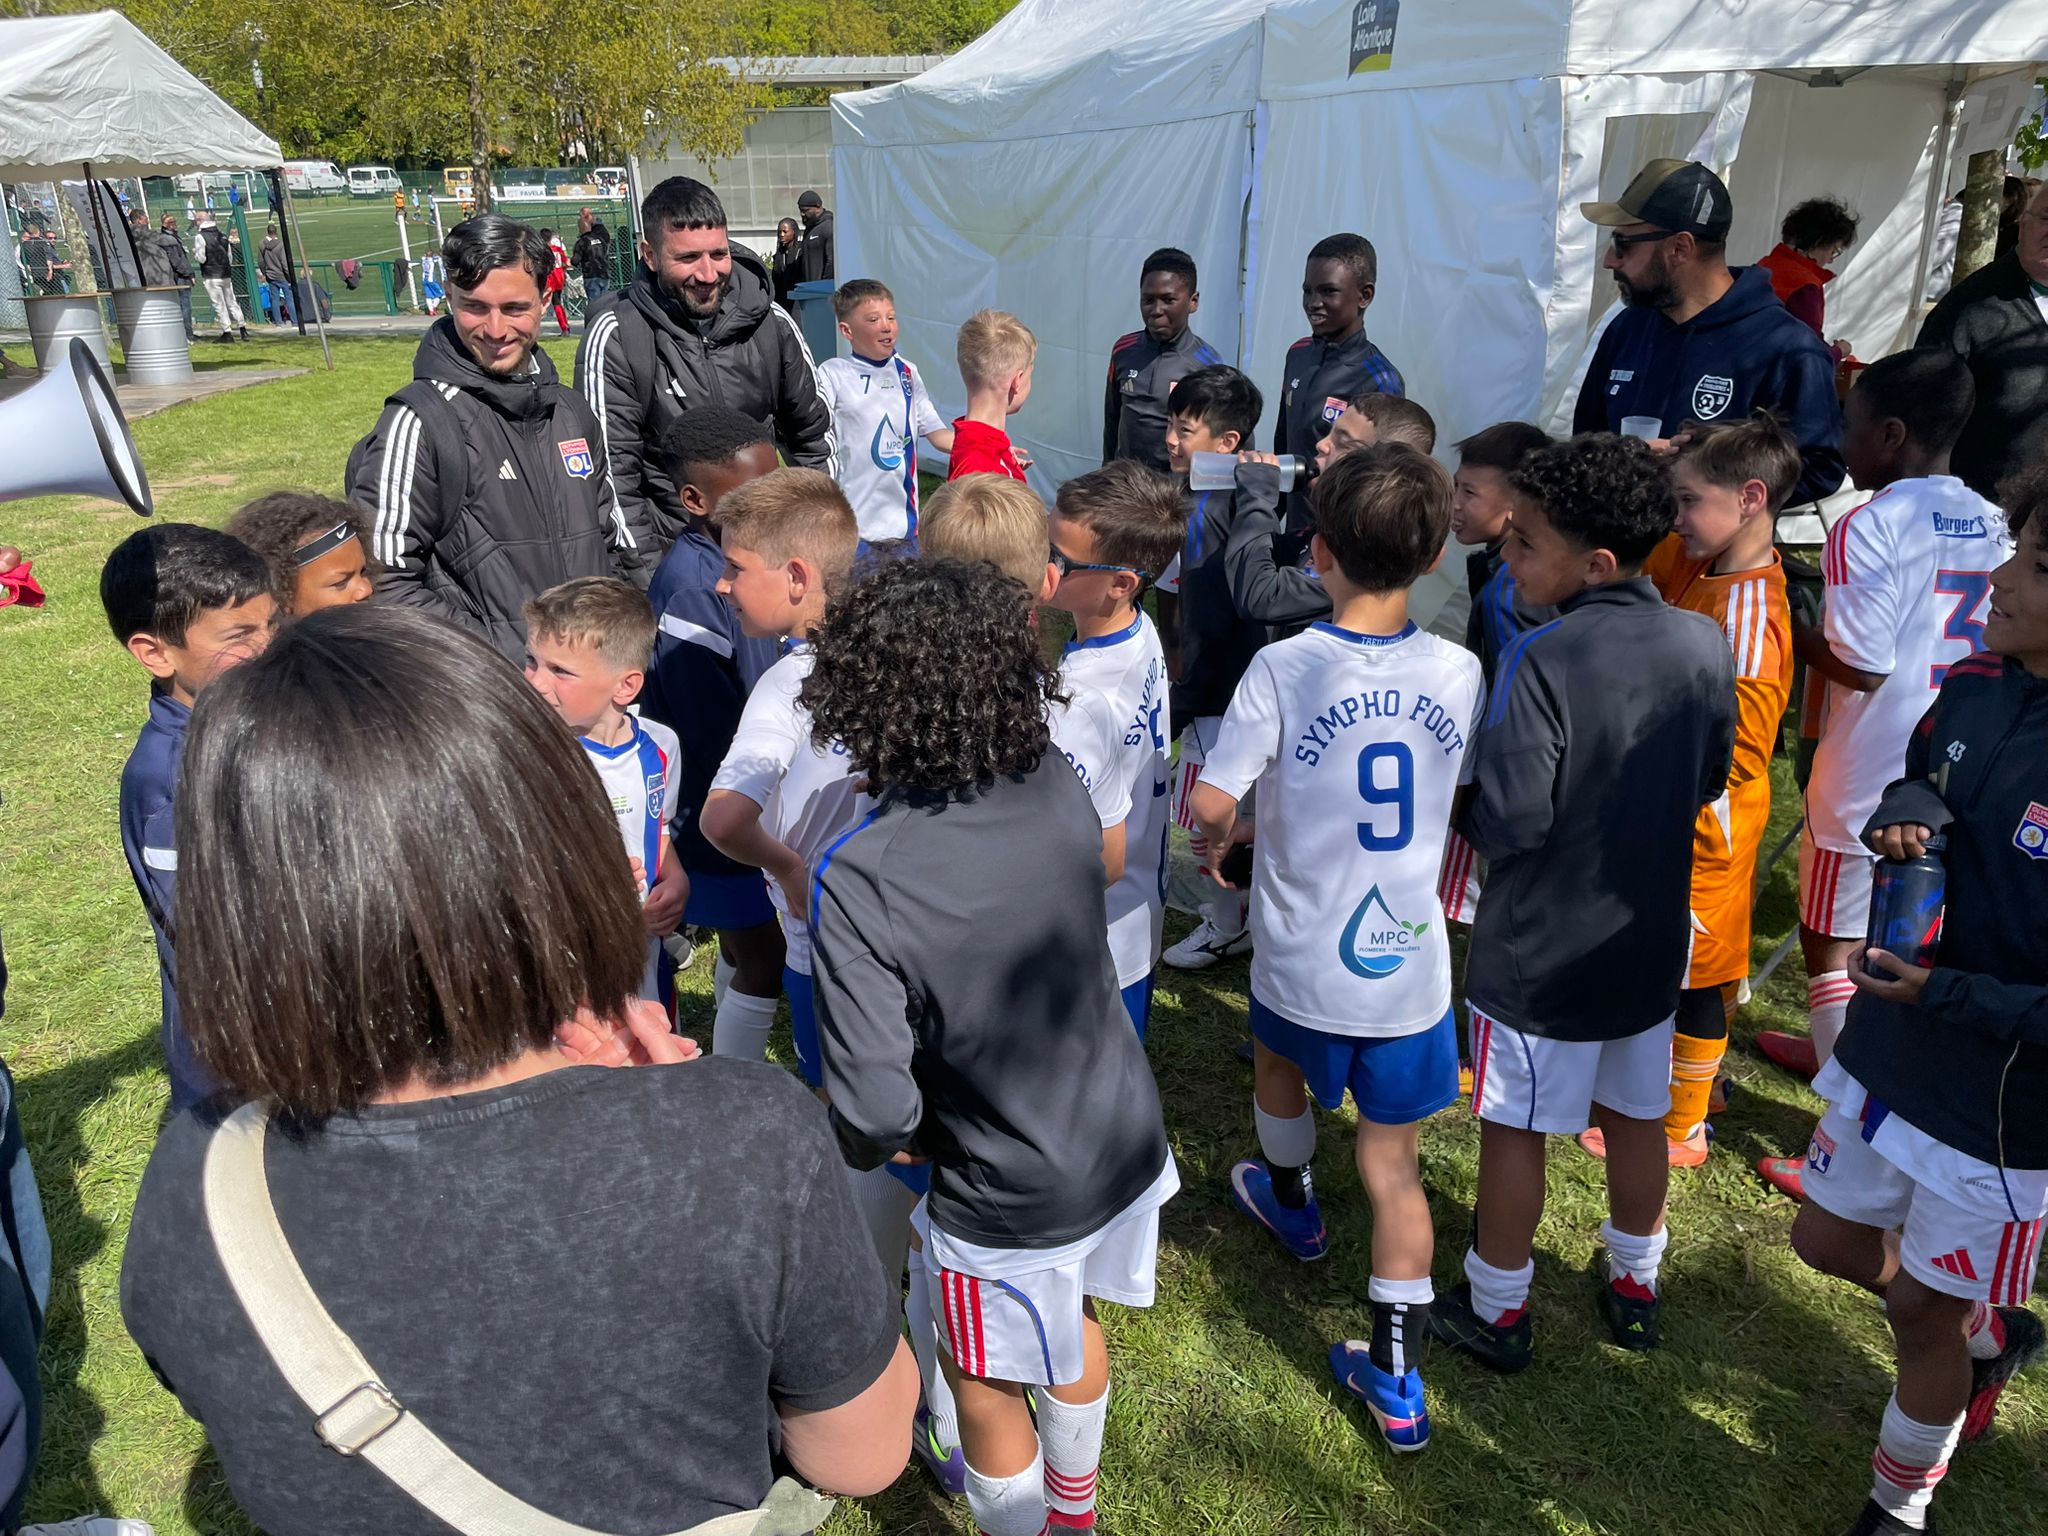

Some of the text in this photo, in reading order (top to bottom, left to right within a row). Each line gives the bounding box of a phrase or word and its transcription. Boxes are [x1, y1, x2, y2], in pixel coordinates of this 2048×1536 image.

[1353, 25, 1393, 55] Atlantique
[860, 374, 871, 395] 7
[1295, 690, 1464, 767] SYMPHO FOOT
[1946, 740, 1967, 762] 43
[1357, 741, 1414, 852] 9
[1370, 931, 1409, 945] MPC
